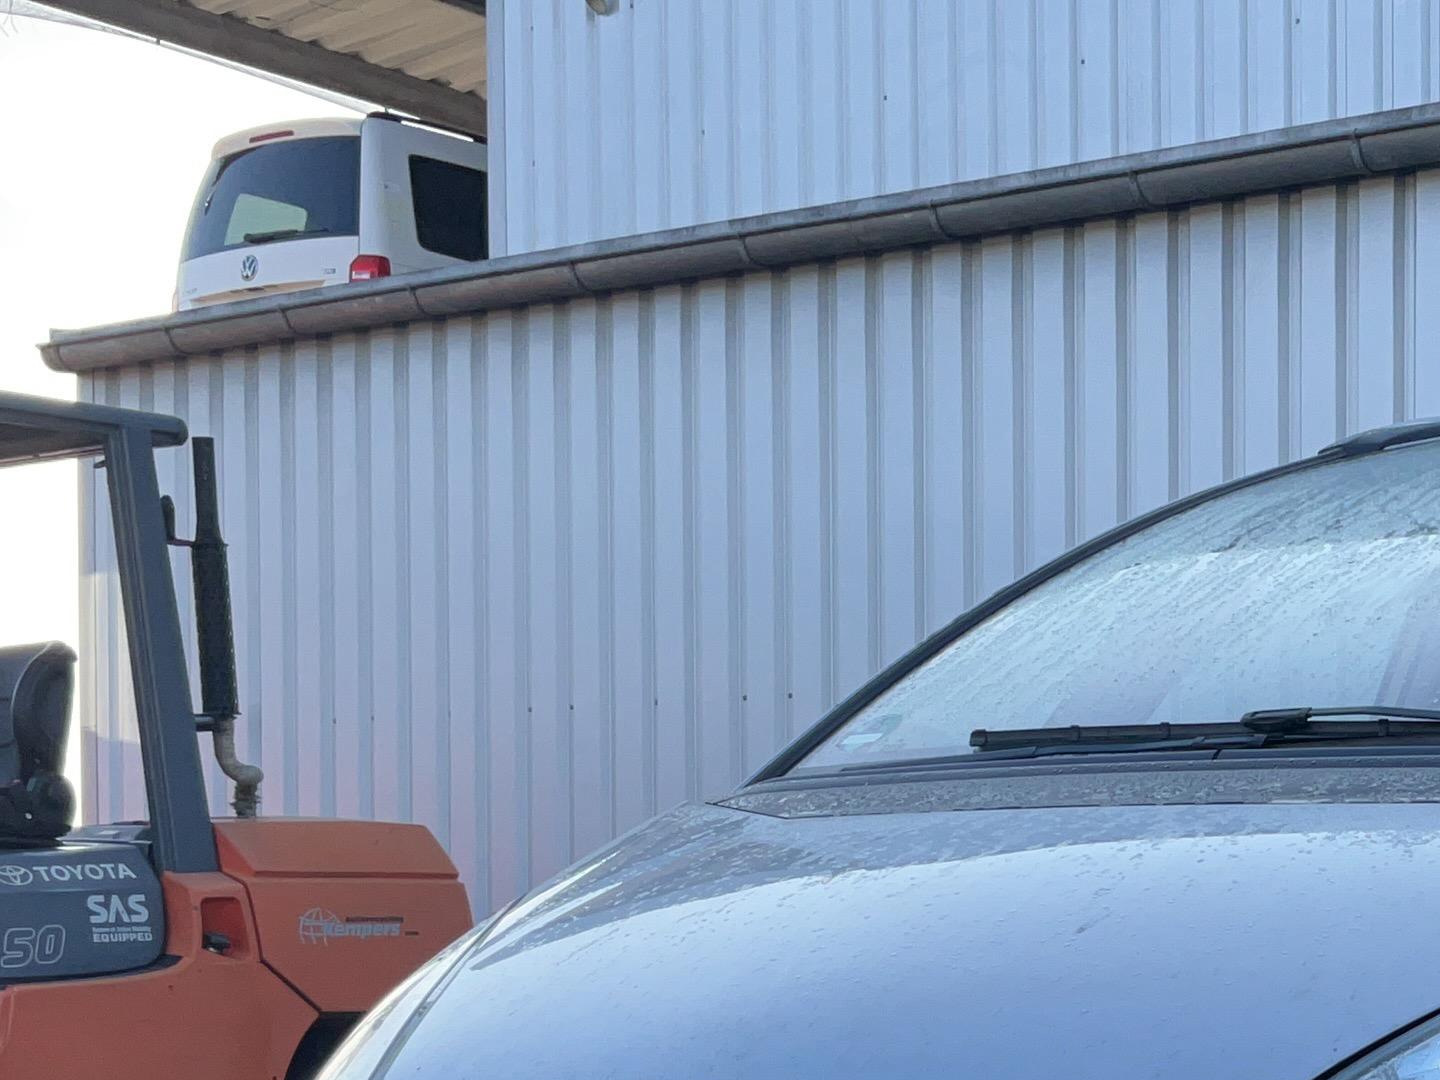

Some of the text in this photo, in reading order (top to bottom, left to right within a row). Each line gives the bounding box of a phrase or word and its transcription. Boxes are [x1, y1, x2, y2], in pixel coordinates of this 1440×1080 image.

[32, 862, 137, 882] TOYOTA
[87, 894, 149, 923] SAS
[1, 924, 66, 968] 50
[92, 932, 153, 942] EQUIPPED
